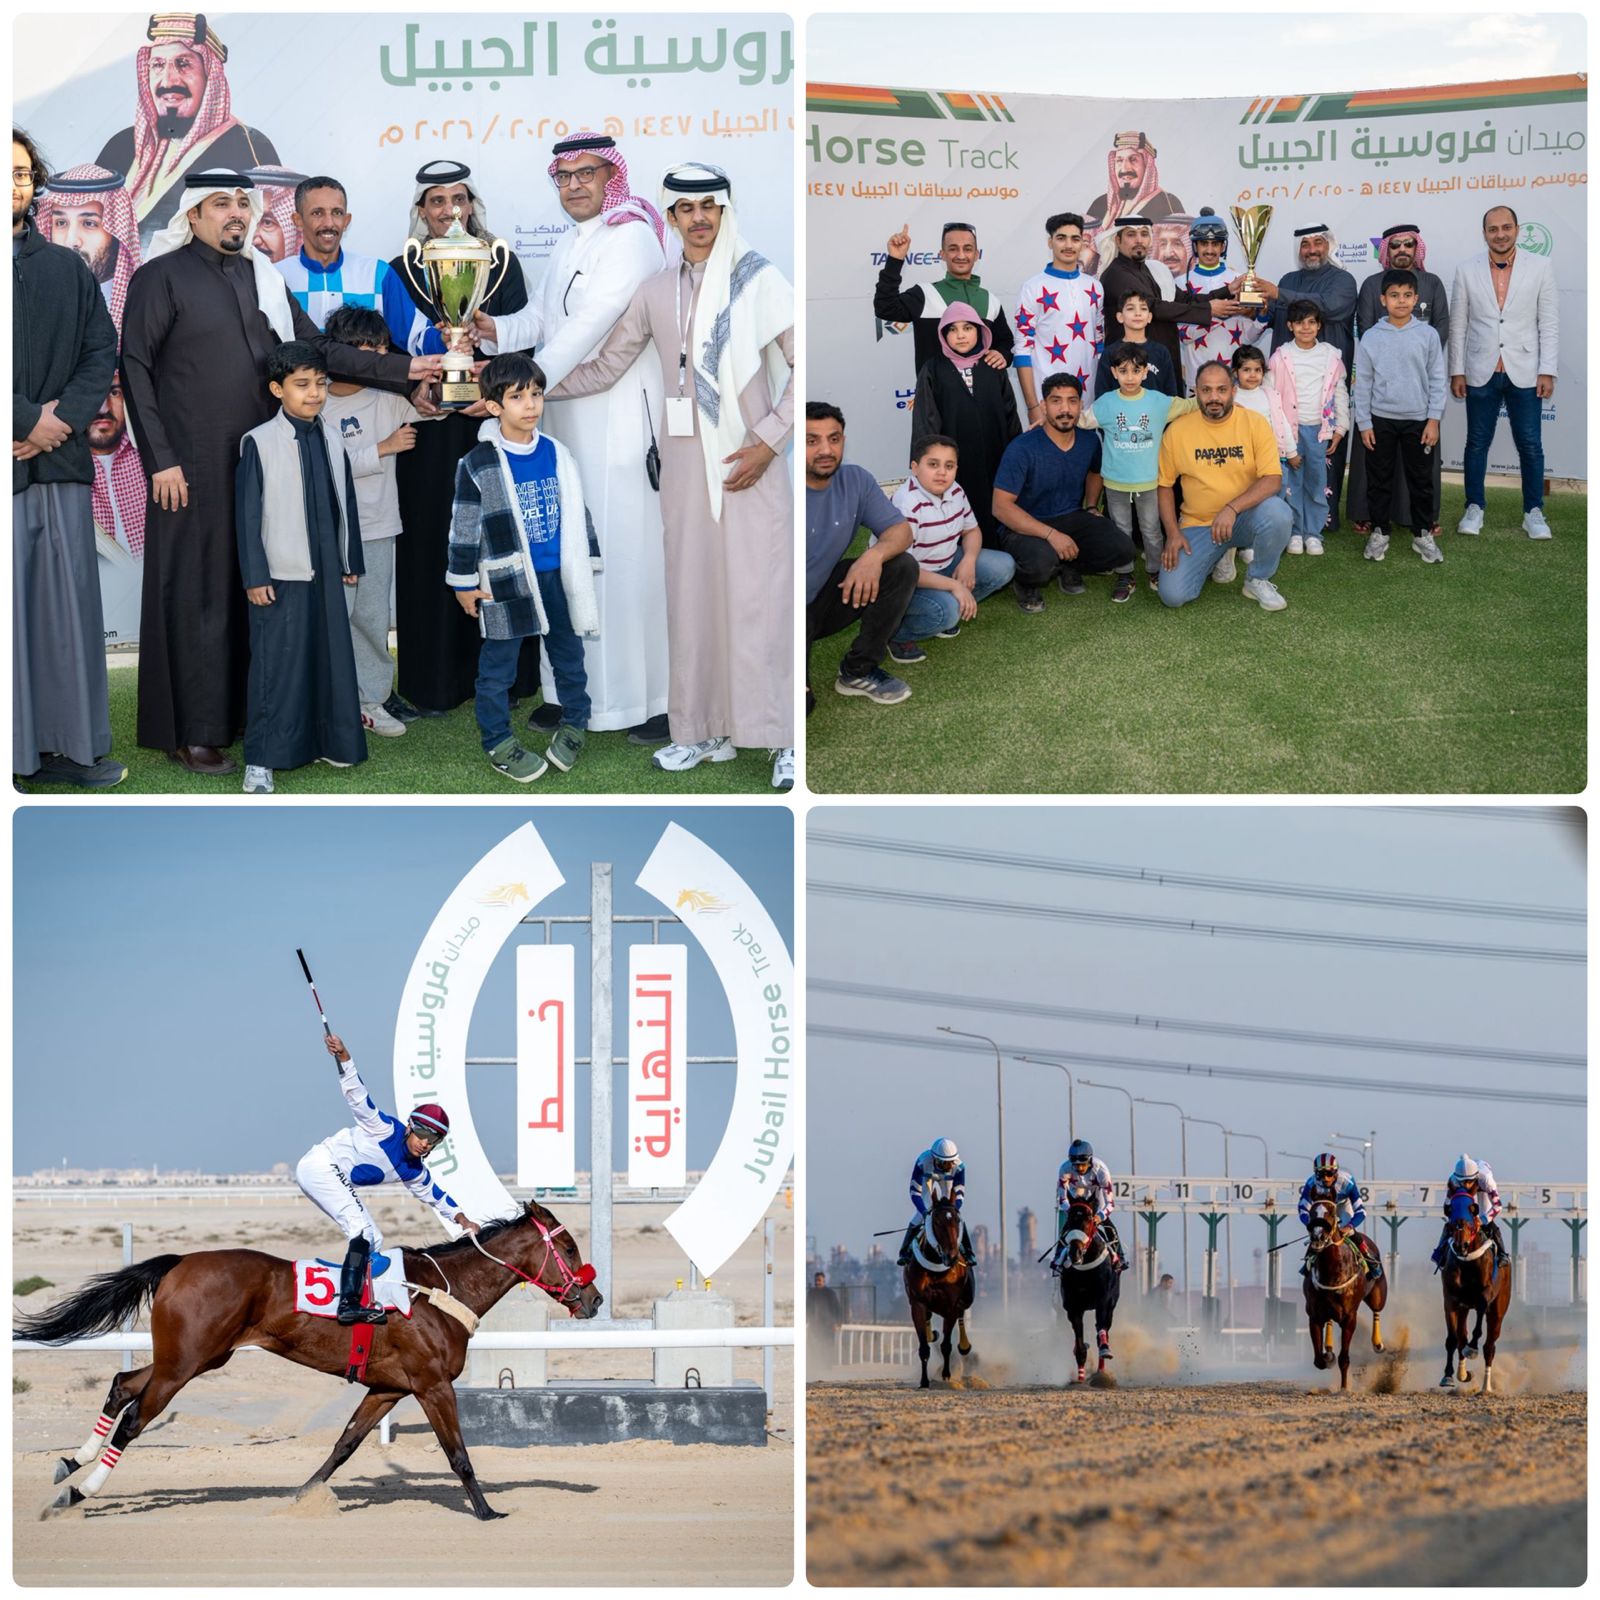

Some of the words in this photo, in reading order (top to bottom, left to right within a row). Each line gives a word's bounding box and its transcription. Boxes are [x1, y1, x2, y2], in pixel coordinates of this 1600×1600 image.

[379, 20, 559, 92] الجبيل
[583, 18, 794, 89] روسية
[415, 118, 473, 141] ٢٠٢٦
[509, 117, 569, 140] ٢٠٢٥
[633, 114, 692, 137] ١٤٤٧
[702, 107, 779, 138] الجبيل
[379, 124, 404, 148] م
[1350, 119, 1497, 168] فروسية
[1507, 124, 1587, 157] ميدان
[938, 139, 1020, 170] Track
[1238, 128, 1338, 172] الجبيل
[807, 182, 845, 197] ١٤٤٧
[1378, 180, 1411, 196] ١٤٤٧
[1416, 176, 1461, 195] الجبيل
[1466, 174, 1527, 192] سباقات
[1530, 172, 1588, 189] موسم
[851, 181, 899, 199] الجبيل
[903, 182, 963, 200] سباقات
[966, 184, 1019, 200] موسم
[1237, 187, 1252, 202] م
[1256, 185, 1290, 200] ٢٠٢٦
[1308, 184, 1343, 198] ٢٠٢٥
[515, 223, 569, 237] الملكية
[870, 252, 934, 266] TANEE
[1194, 445, 1244, 461] PARADISE
[444, 916, 481, 962] ميدان
[731, 922, 771, 979] Track
[410, 960, 450, 1080] فروسية
[762, 983, 791, 1080] Horse
[527, 999, 565, 1133] خط
[634, 973, 682, 1158] النهاية
[743, 1090, 787, 1184] Jubail
[1112, 1182, 1130, 1198] 12
[1175, 1183, 1190, 1199] 11
[1233, 1184, 1253, 1200] 10
[1360, 1187, 1370, 1202] 8
[1419, 1187, 1430, 1202] 7
[1542, 1188, 1551, 1204] 5
[304, 1266, 336, 1306] 5
